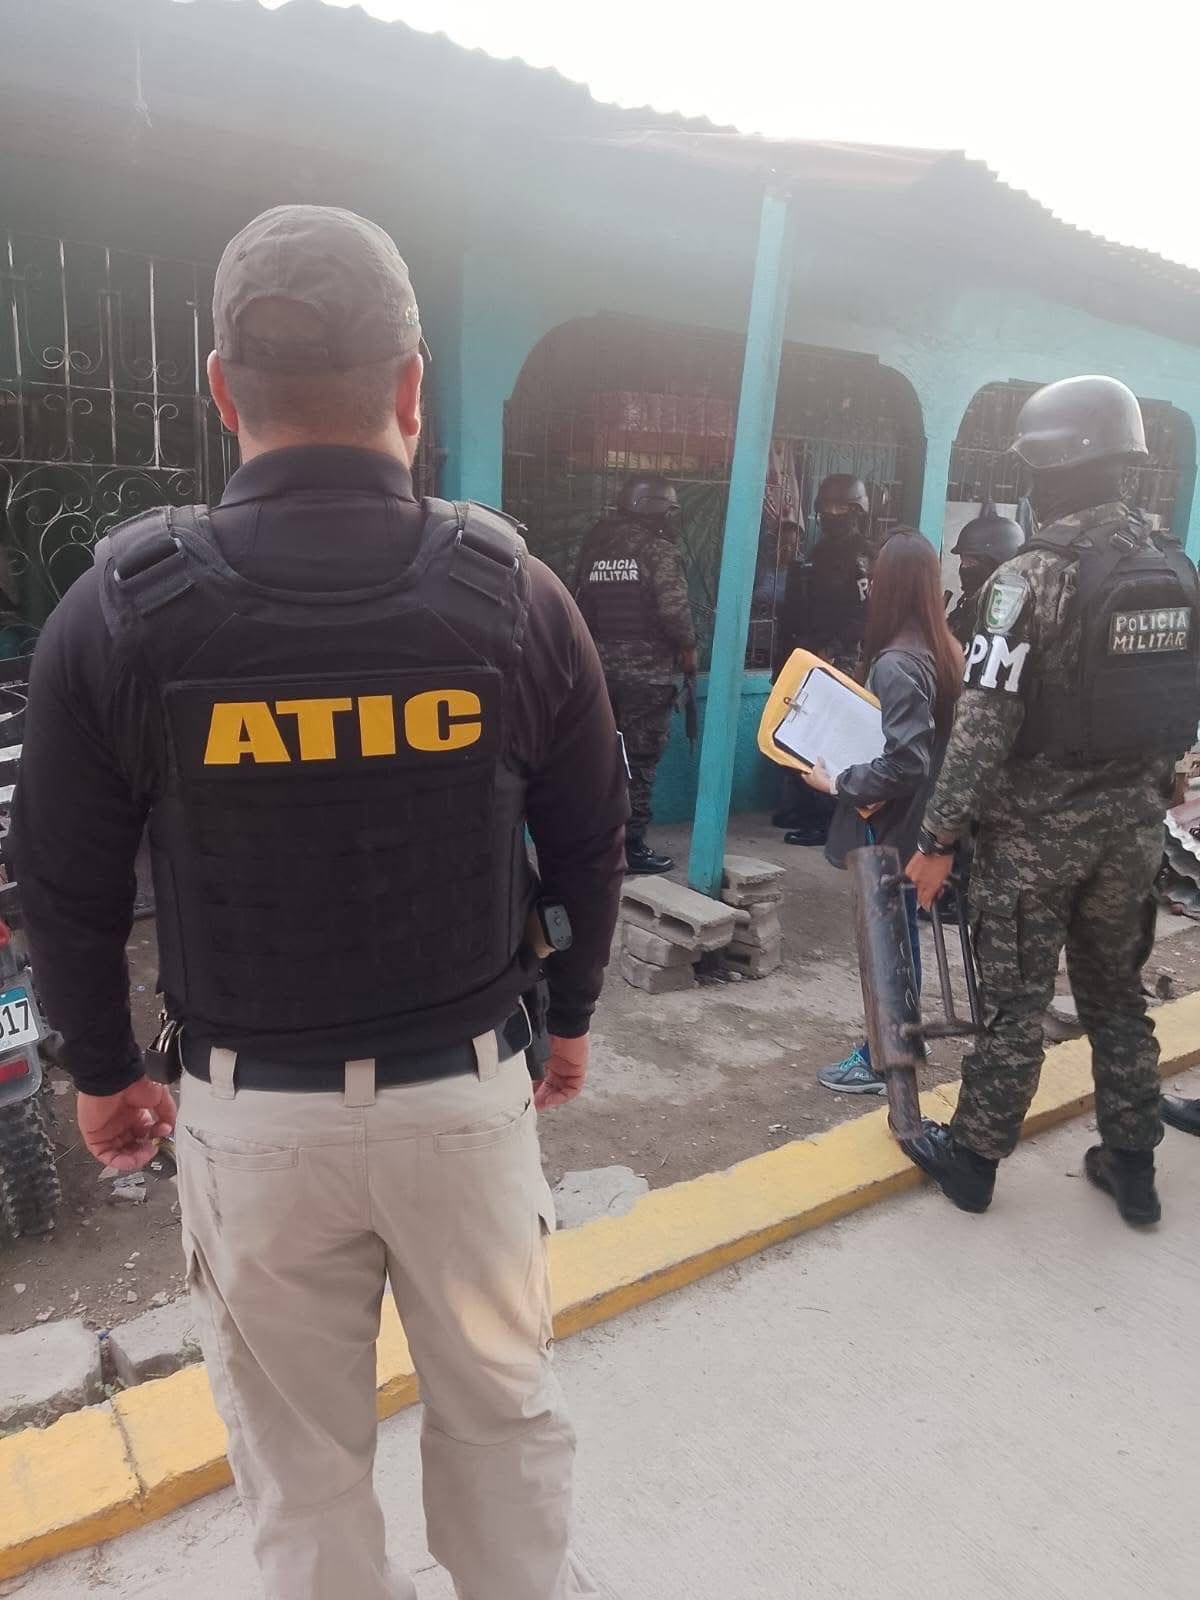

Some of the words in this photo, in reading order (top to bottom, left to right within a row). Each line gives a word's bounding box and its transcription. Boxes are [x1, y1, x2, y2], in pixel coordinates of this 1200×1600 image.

[589, 570, 639, 582] MILITAR
[1116, 611, 1186, 632] POLICIA
[1112, 631, 1186, 651] MILITAR
[963, 634, 1031, 692] PM
[204, 689, 481, 764] ATIC
[0, 1000, 29, 1040] 17
